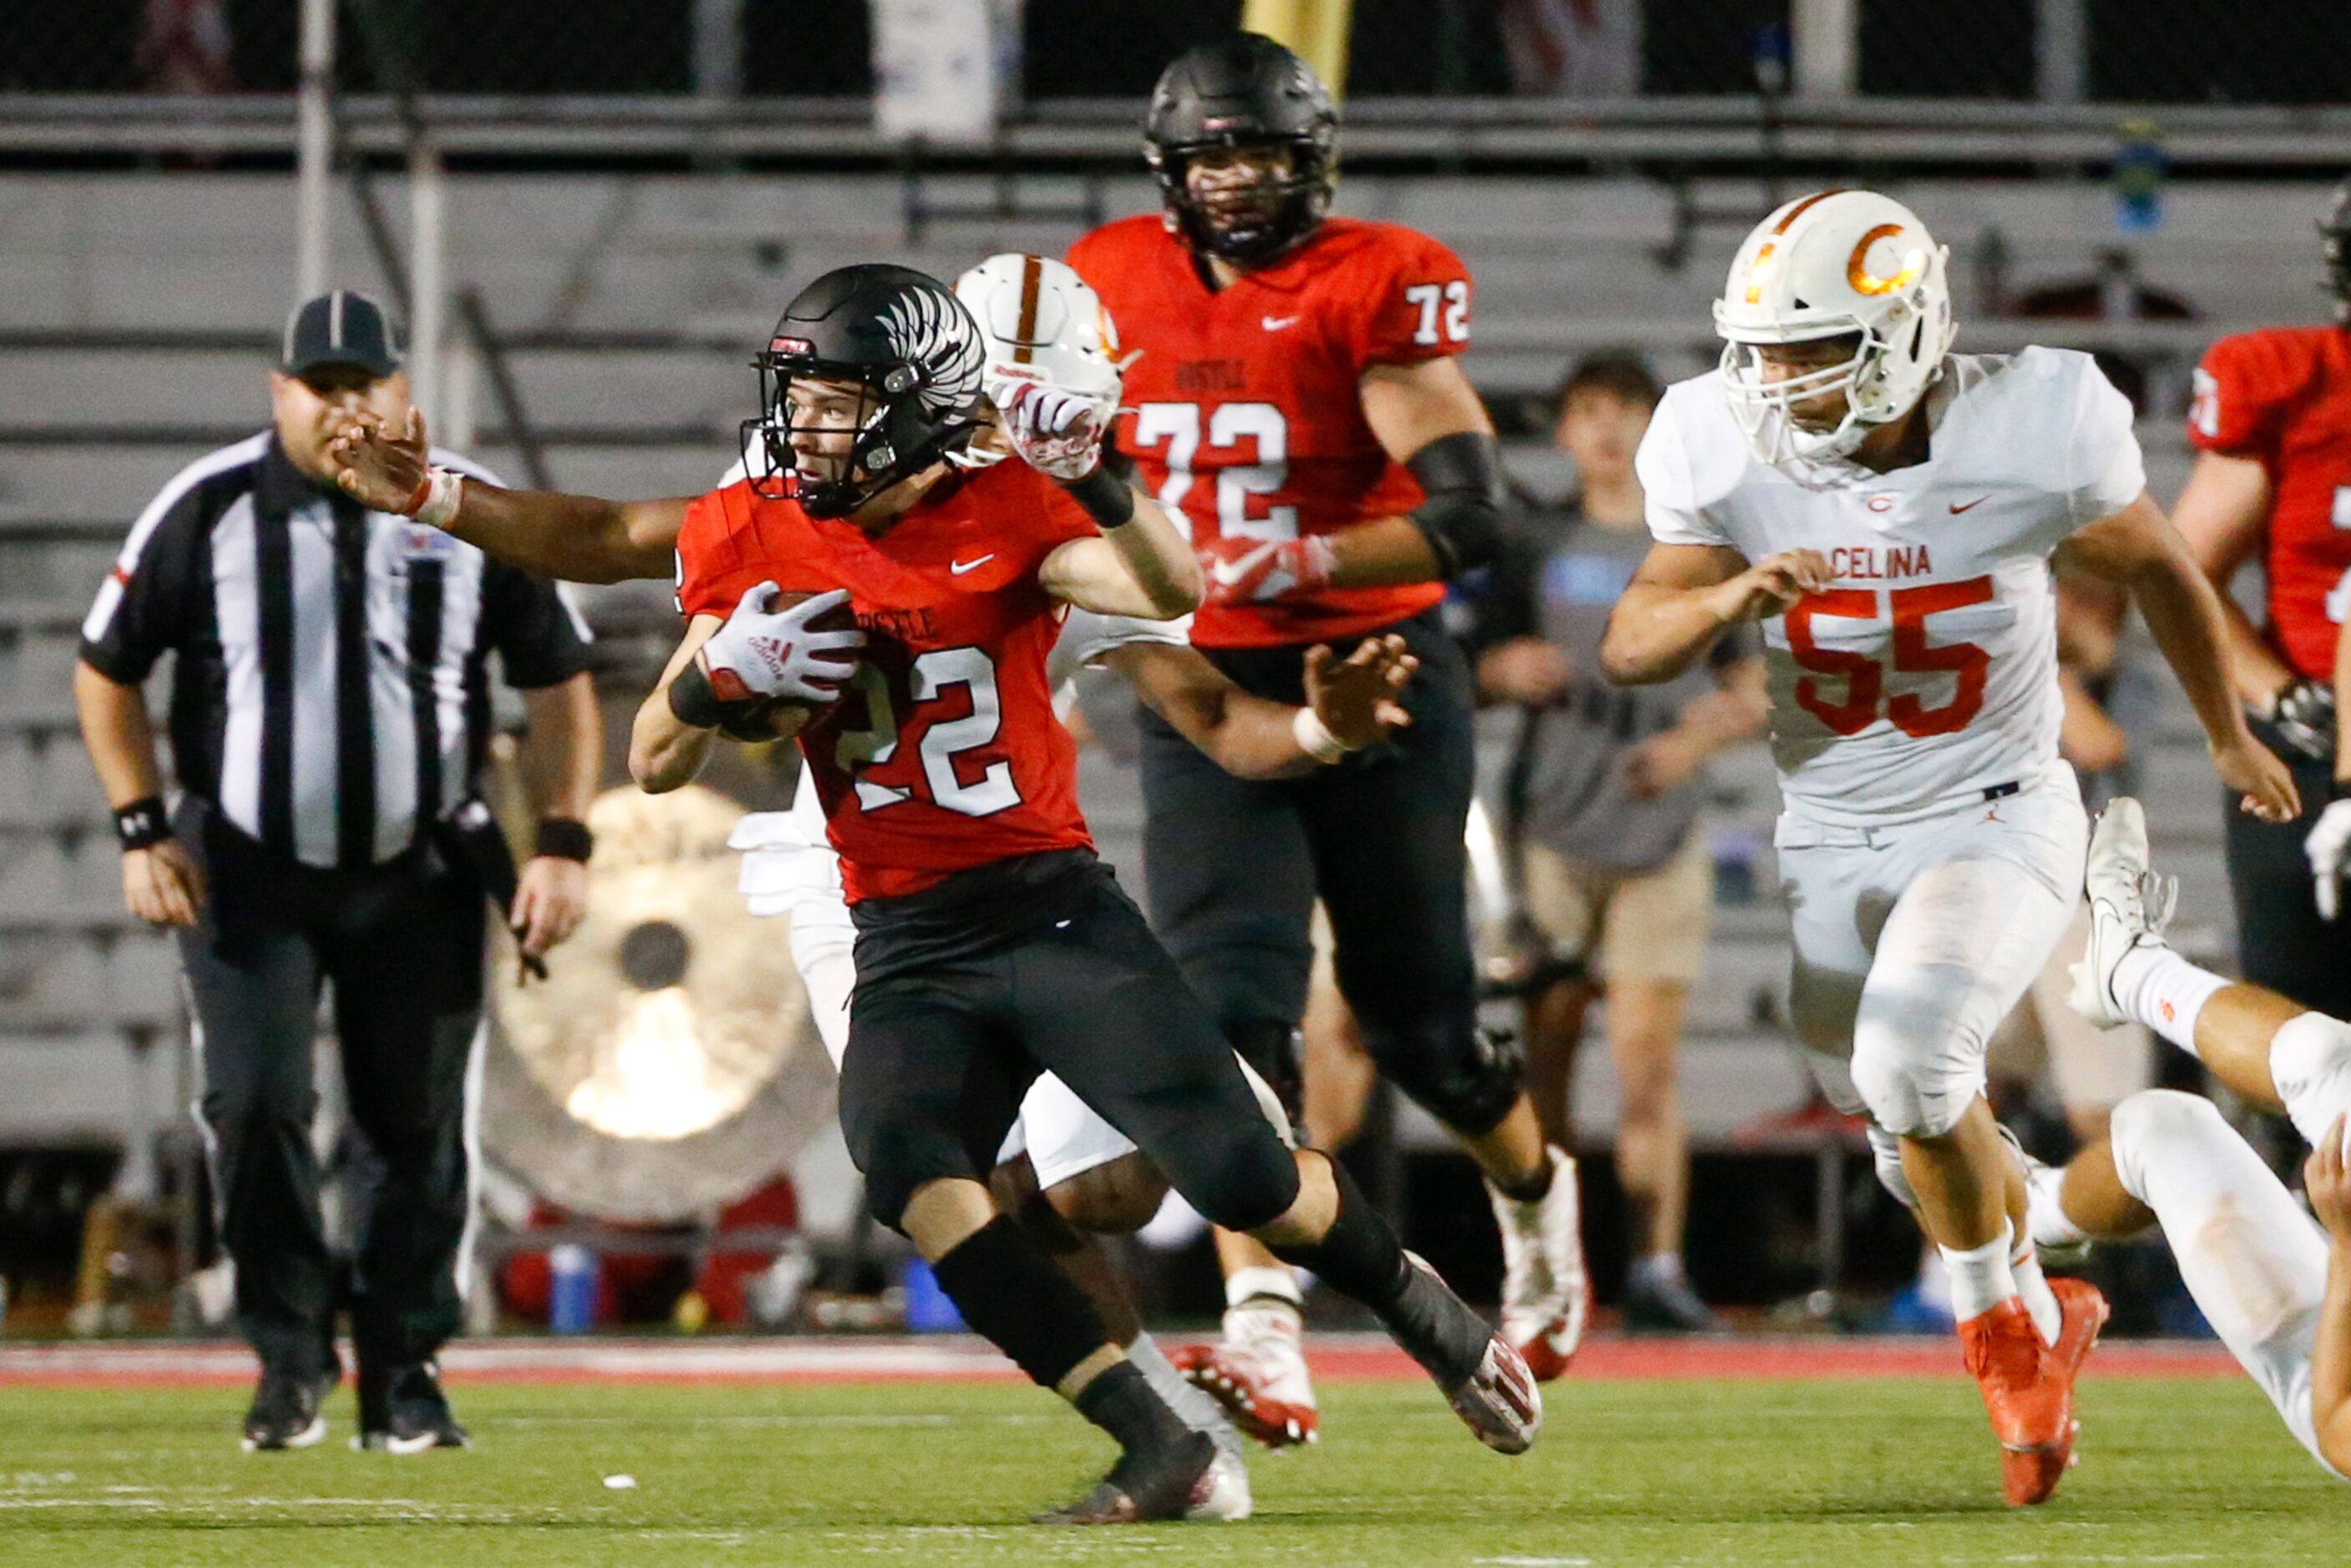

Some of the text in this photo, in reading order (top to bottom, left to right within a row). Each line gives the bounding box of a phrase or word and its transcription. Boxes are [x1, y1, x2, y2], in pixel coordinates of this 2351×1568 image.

[1406, 279, 1469, 345] 72
[1846, 223, 1923, 296] C
[1136, 402, 1298, 543] 72
[1832, 544, 1932, 579] CELINA
[1784, 574, 1995, 738] 55
[836, 646, 1021, 818] 22
